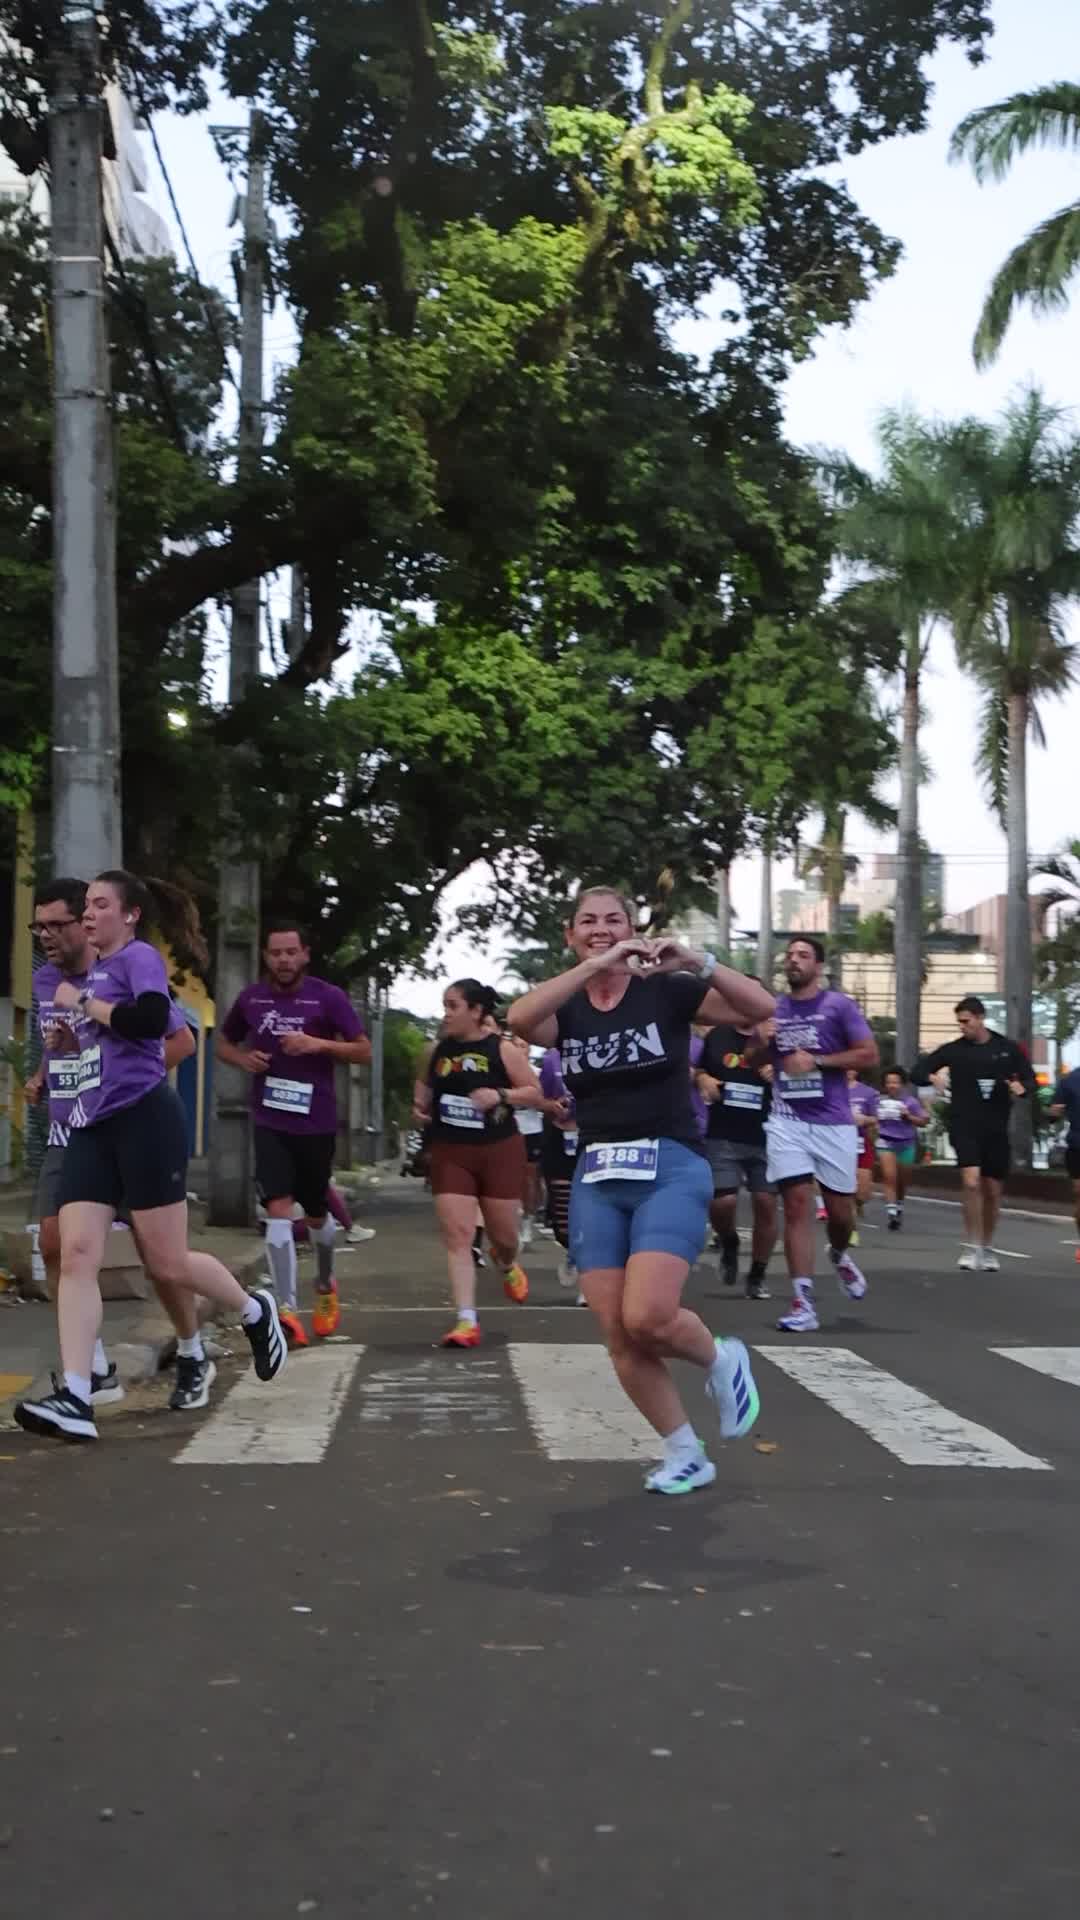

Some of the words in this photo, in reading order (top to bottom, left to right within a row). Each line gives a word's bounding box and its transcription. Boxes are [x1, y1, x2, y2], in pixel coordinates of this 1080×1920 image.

[562, 1022, 665, 1075] RUN
[58, 1074, 79, 1086] 551
[596, 1148, 640, 1165] 5288
